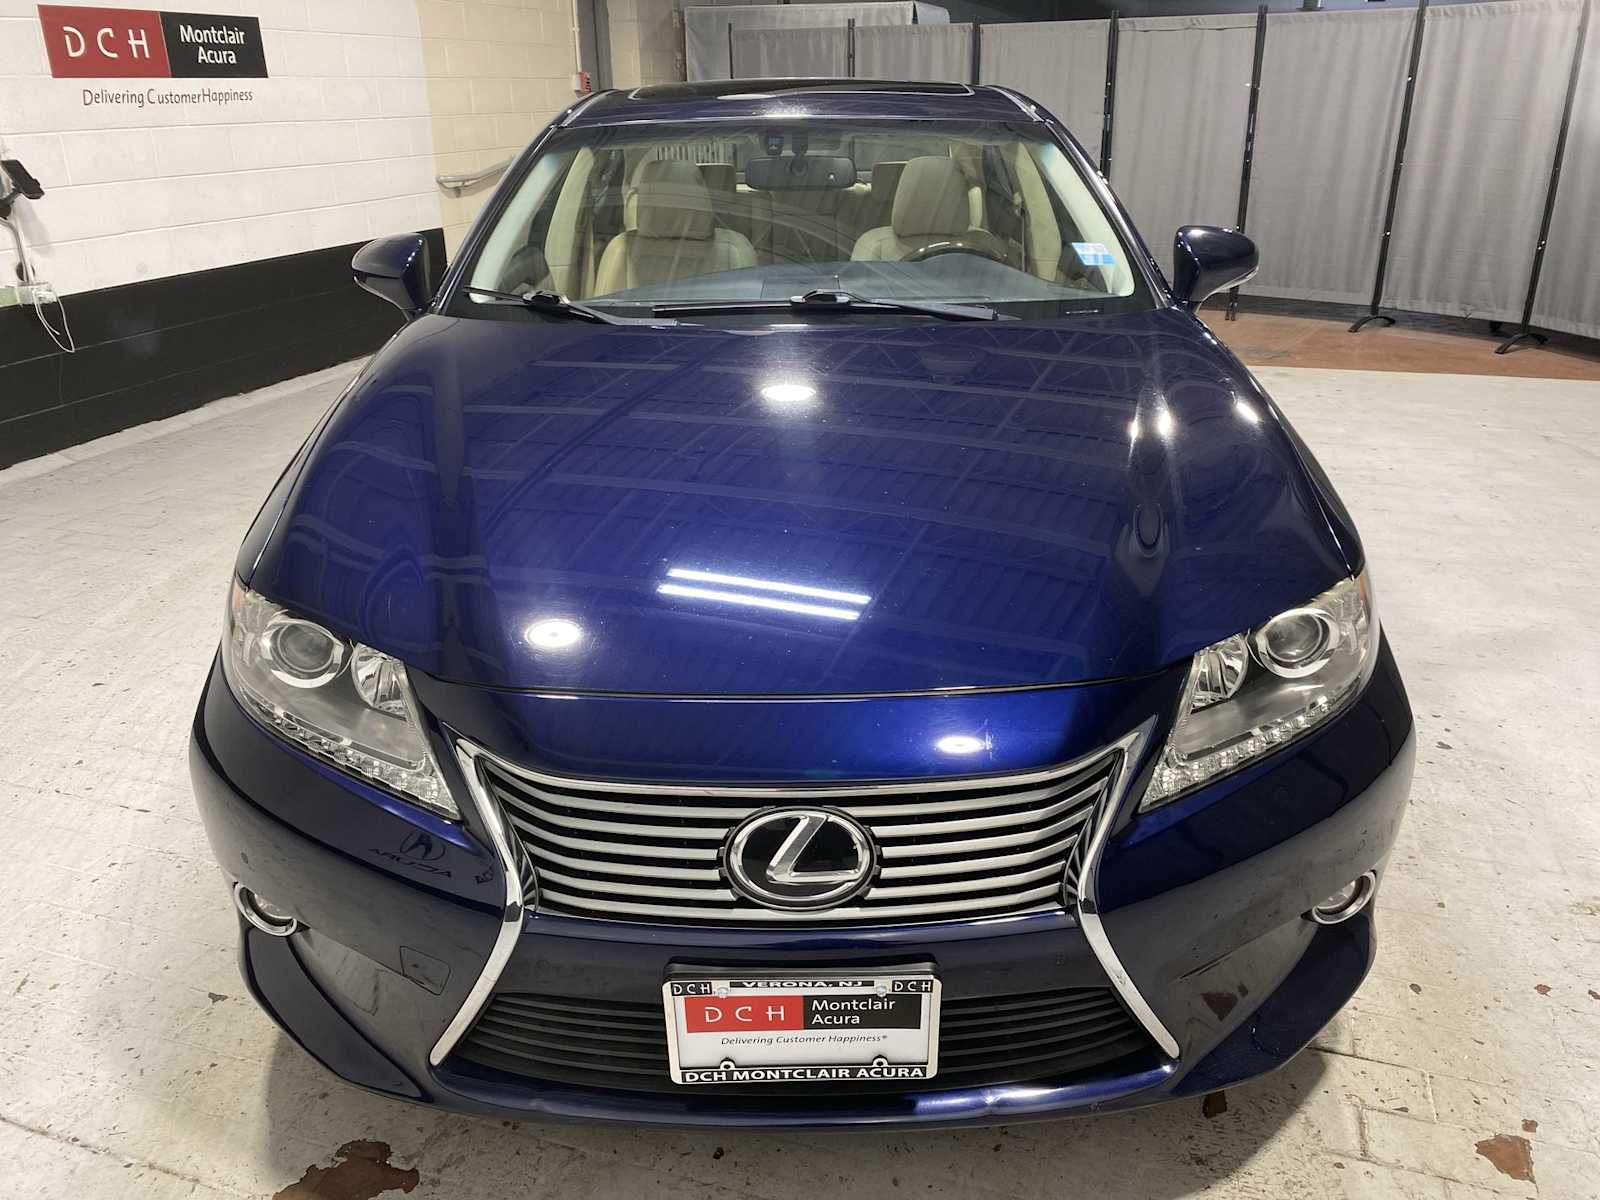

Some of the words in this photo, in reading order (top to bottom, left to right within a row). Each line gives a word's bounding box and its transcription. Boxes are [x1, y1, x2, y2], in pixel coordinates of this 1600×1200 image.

[179, 24, 245, 45] Montclair
[197, 47, 237, 65] Acura
[82, 89, 145, 108] Delivering
[811, 998, 896, 1011] Montclair
[811, 1014, 861, 1025] Acura
[721, 1036, 773, 1046] Delivering
[776, 1035, 826, 1044] Customer
[685, 1070, 727, 1083] DCH
[733, 1067, 850, 1081] MONTCLAIR
[856, 1067, 924, 1079] ACURA
